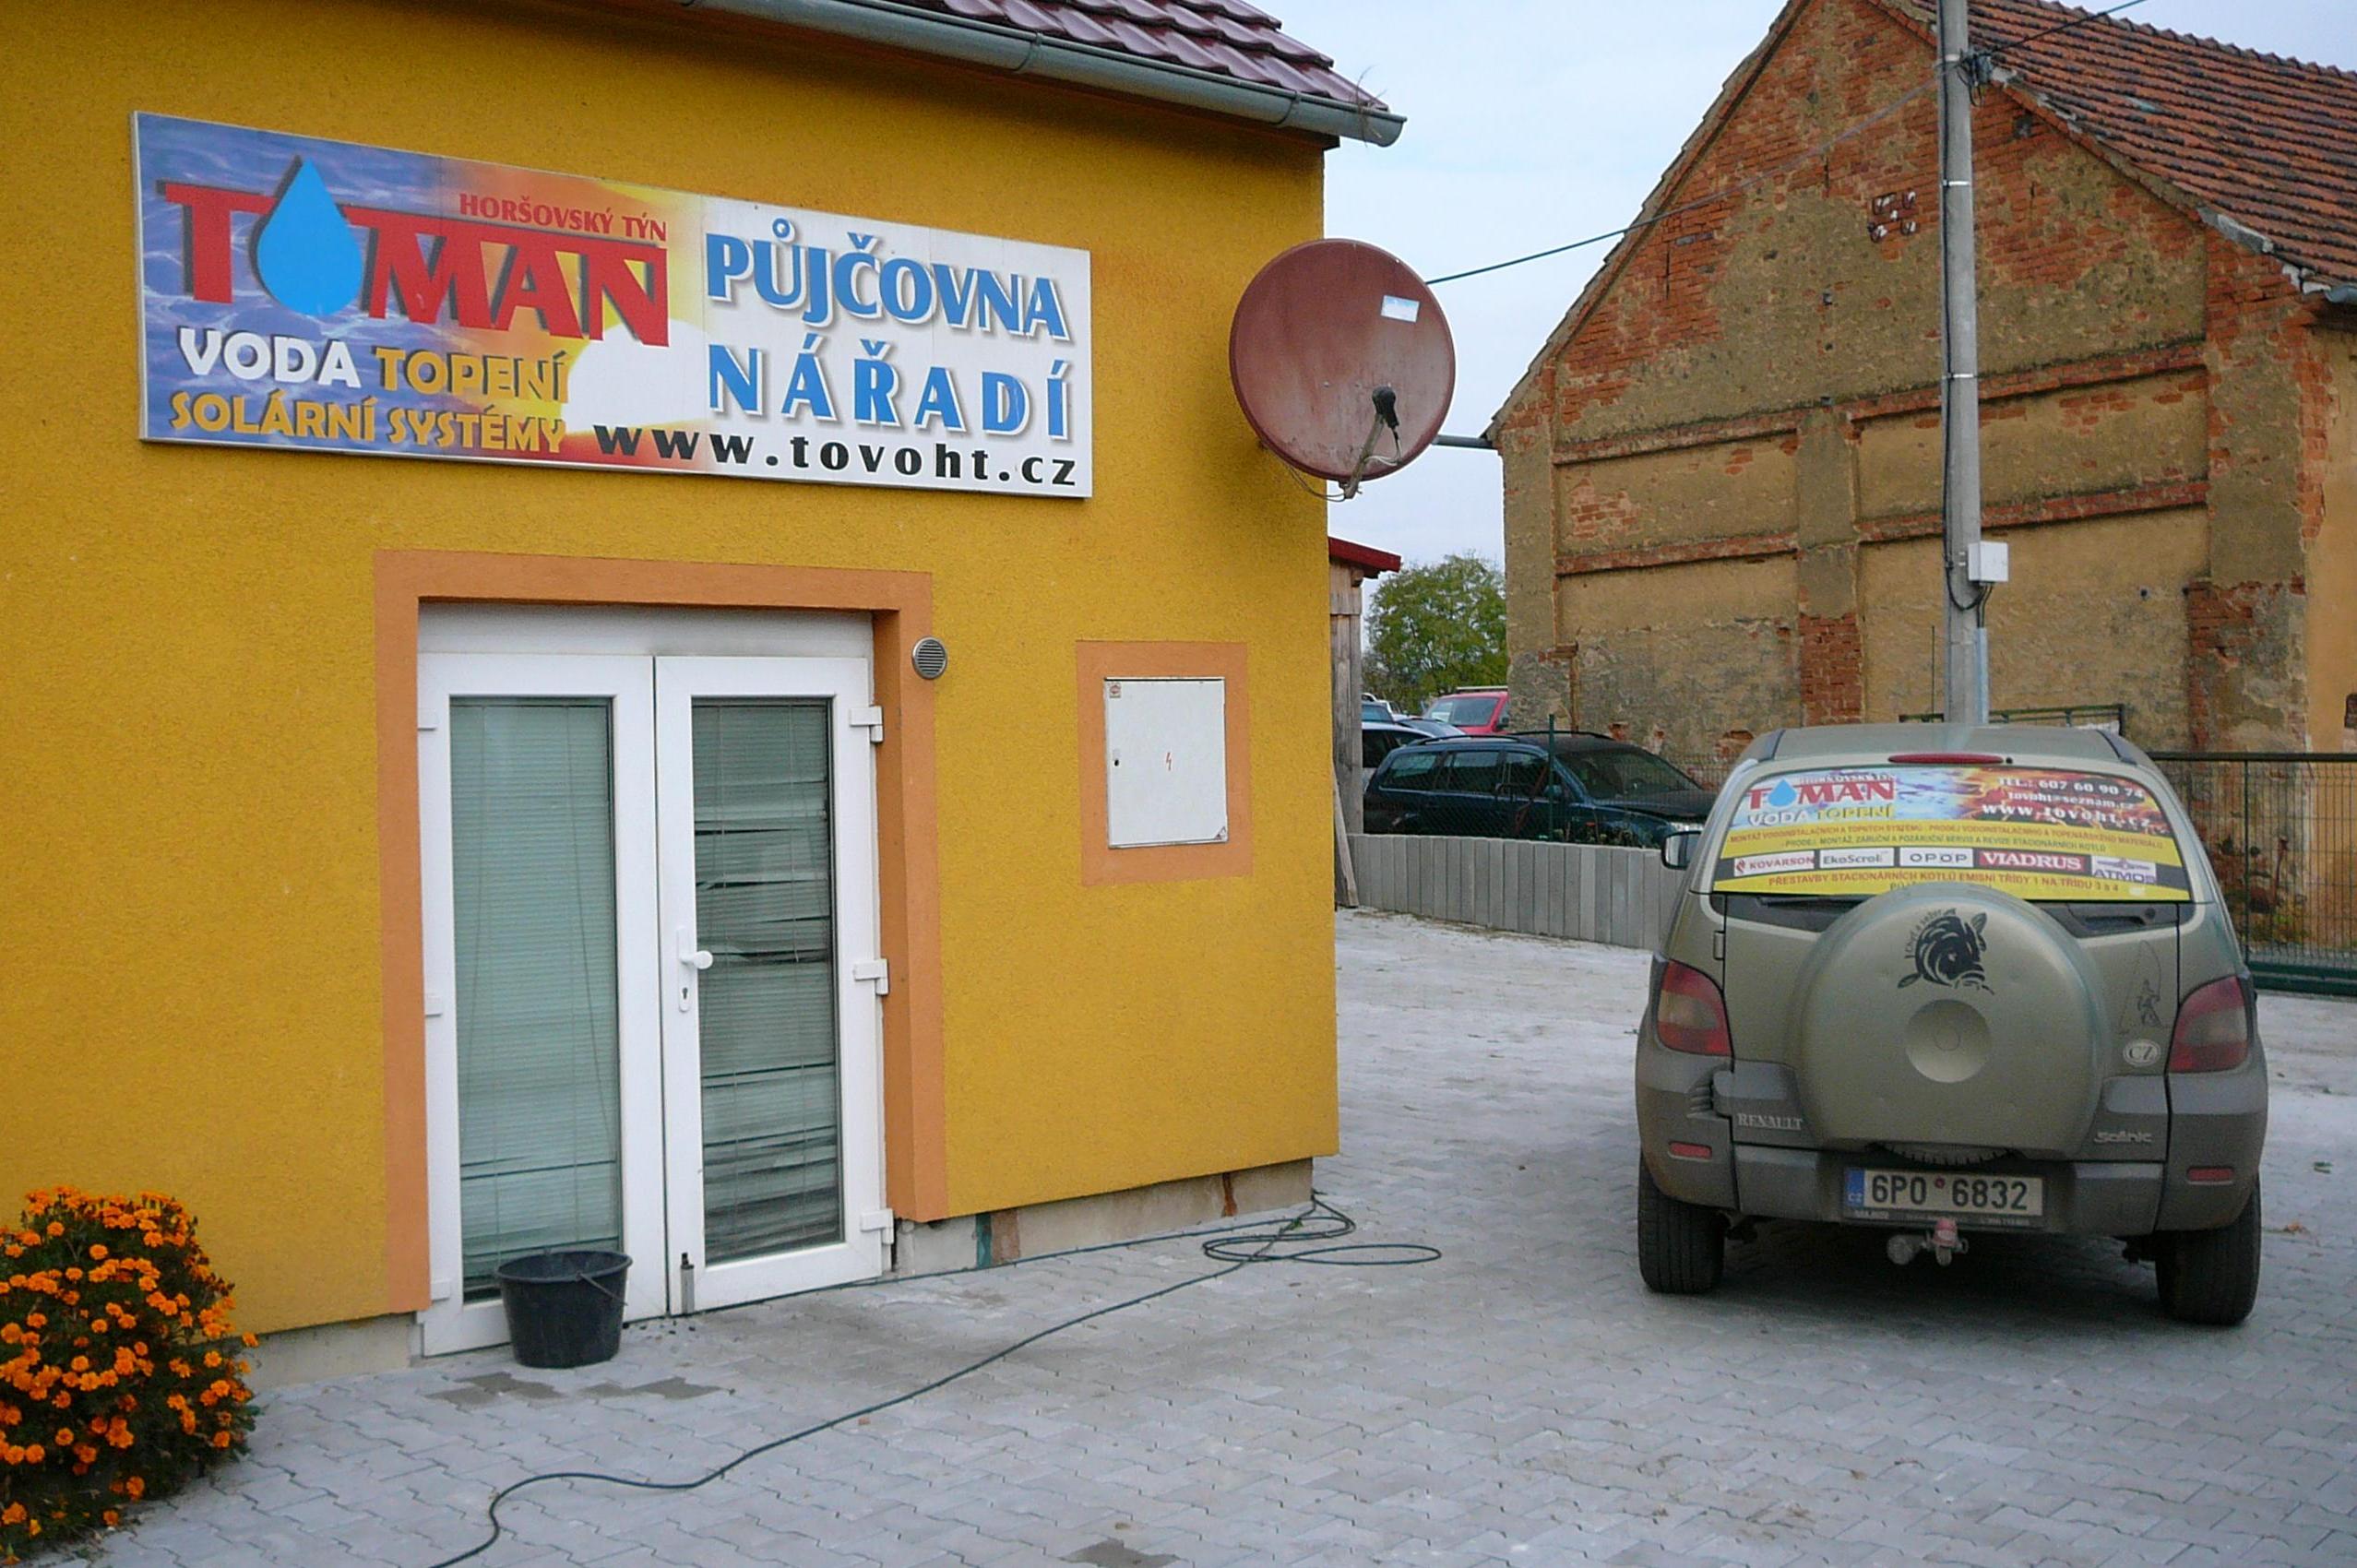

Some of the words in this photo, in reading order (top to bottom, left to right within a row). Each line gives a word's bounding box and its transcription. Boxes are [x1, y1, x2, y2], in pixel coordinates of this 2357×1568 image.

[460, 193, 613, 235] HORŠOVSKÝ
[622, 213, 667, 243] TÝN
[706, 218, 1072, 342] PŮJČOVNA
[179, 327, 362, 389] VODA
[374, 347, 569, 405] TOPENÍ
[707, 333, 1072, 441] NÁŘADÍ
[169, 389, 378, 442] SOLÁRNÍ
[386, 405, 567, 454] SYSTÉMY
[593, 424, 1077, 487] www.tovoht.cz
[2039, 778, 2068, 790] 607
[2074, 782, 2095, 793] 60
[2099, 784, 2120, 796] 90
[2125, 789, 2145, 800] 74
[1748, 810, 1810, 827] VODA
[1749, 855, 1815, 870] KOVARSON
[1910, 853, 1968, 863] OPOP
[1982, 851, 2082, 872] VIADRUS
[2127, 1045, 2158, 1063] CZ
[1736, 1111, 1803, 1132] RENAULT
[1951, 1178, 2029, 1211] 6832
